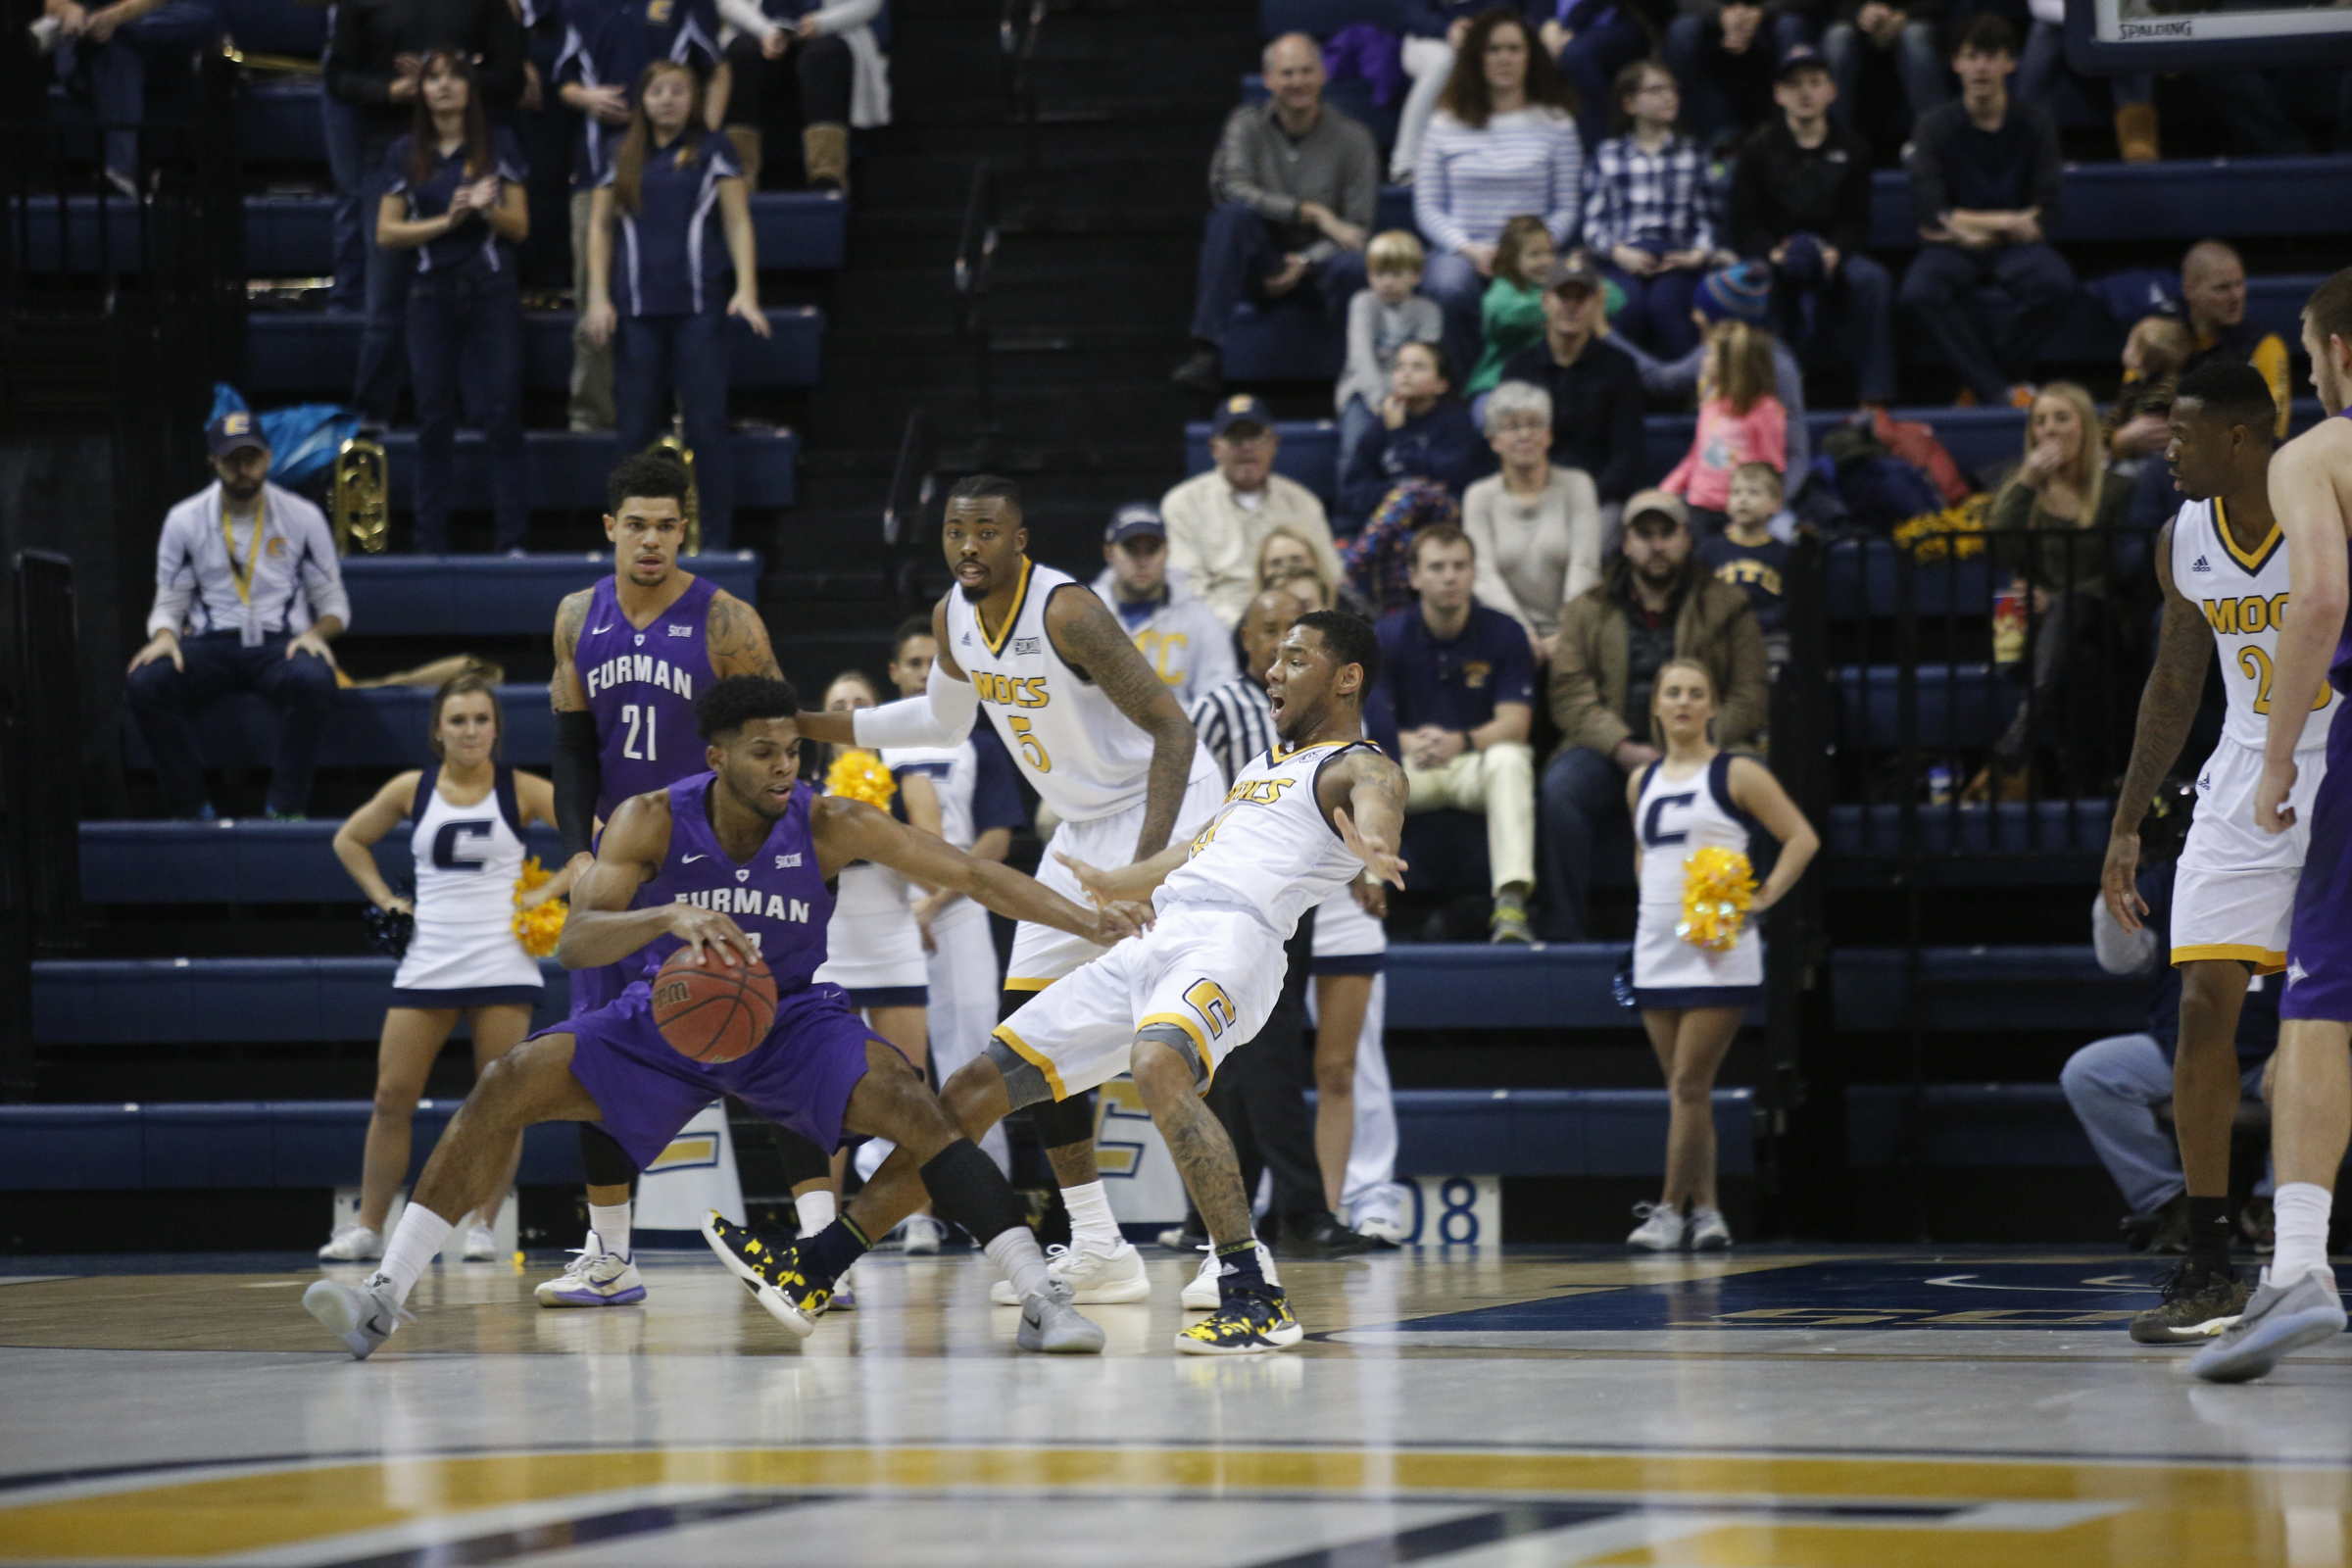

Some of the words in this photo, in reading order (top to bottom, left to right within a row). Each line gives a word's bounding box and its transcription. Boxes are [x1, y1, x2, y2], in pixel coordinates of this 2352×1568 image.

[2119, 20, 2193, 40] SPALDING
[2203, 592, 2290, 636] MOC
[587, 654, 692, 701] FURMAN
[970, 669, 1051, 709] MOCS
[621, 704, 657, 761] 21
[1007, 714, 1052, 773] 5
[432, 817, 497, 875] C
[1643, 790, 1699, 853] C
